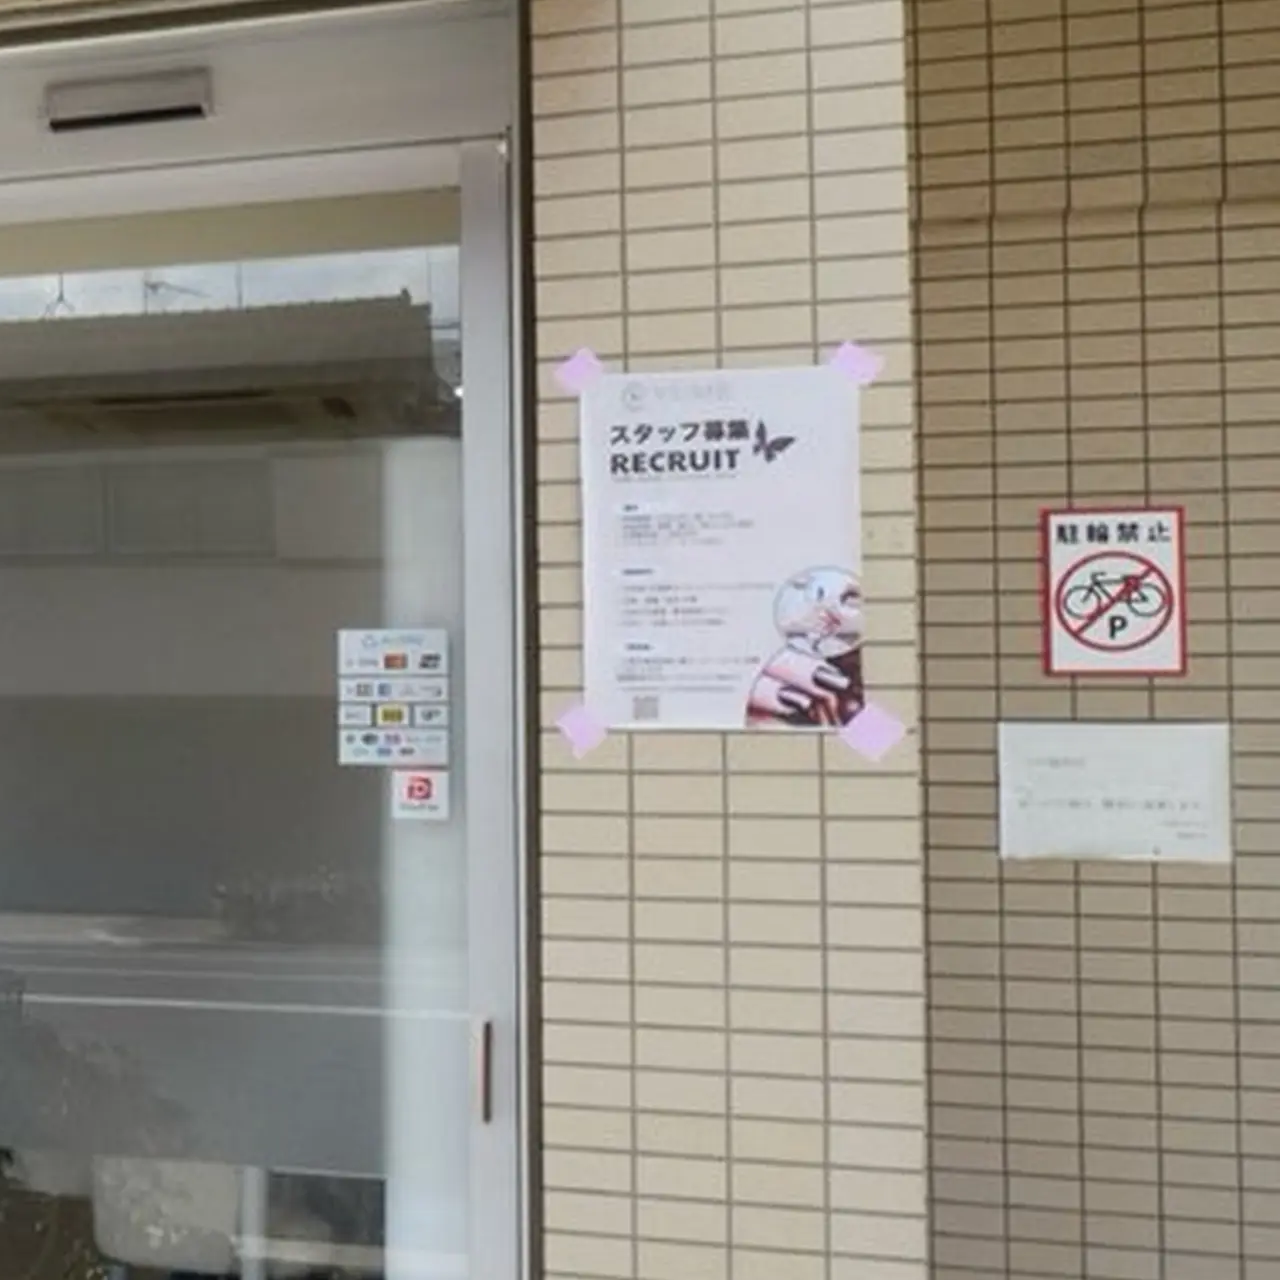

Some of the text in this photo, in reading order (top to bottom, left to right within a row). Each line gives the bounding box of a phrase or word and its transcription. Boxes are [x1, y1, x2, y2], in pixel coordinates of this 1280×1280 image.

[610, 418, 749, 446] スタッフ募集
[611, 449, 740, 475] RECRUIT
[1057, 521, 1172, 544] 駐輪禁止
[1109, 616, 1128, 639] P
